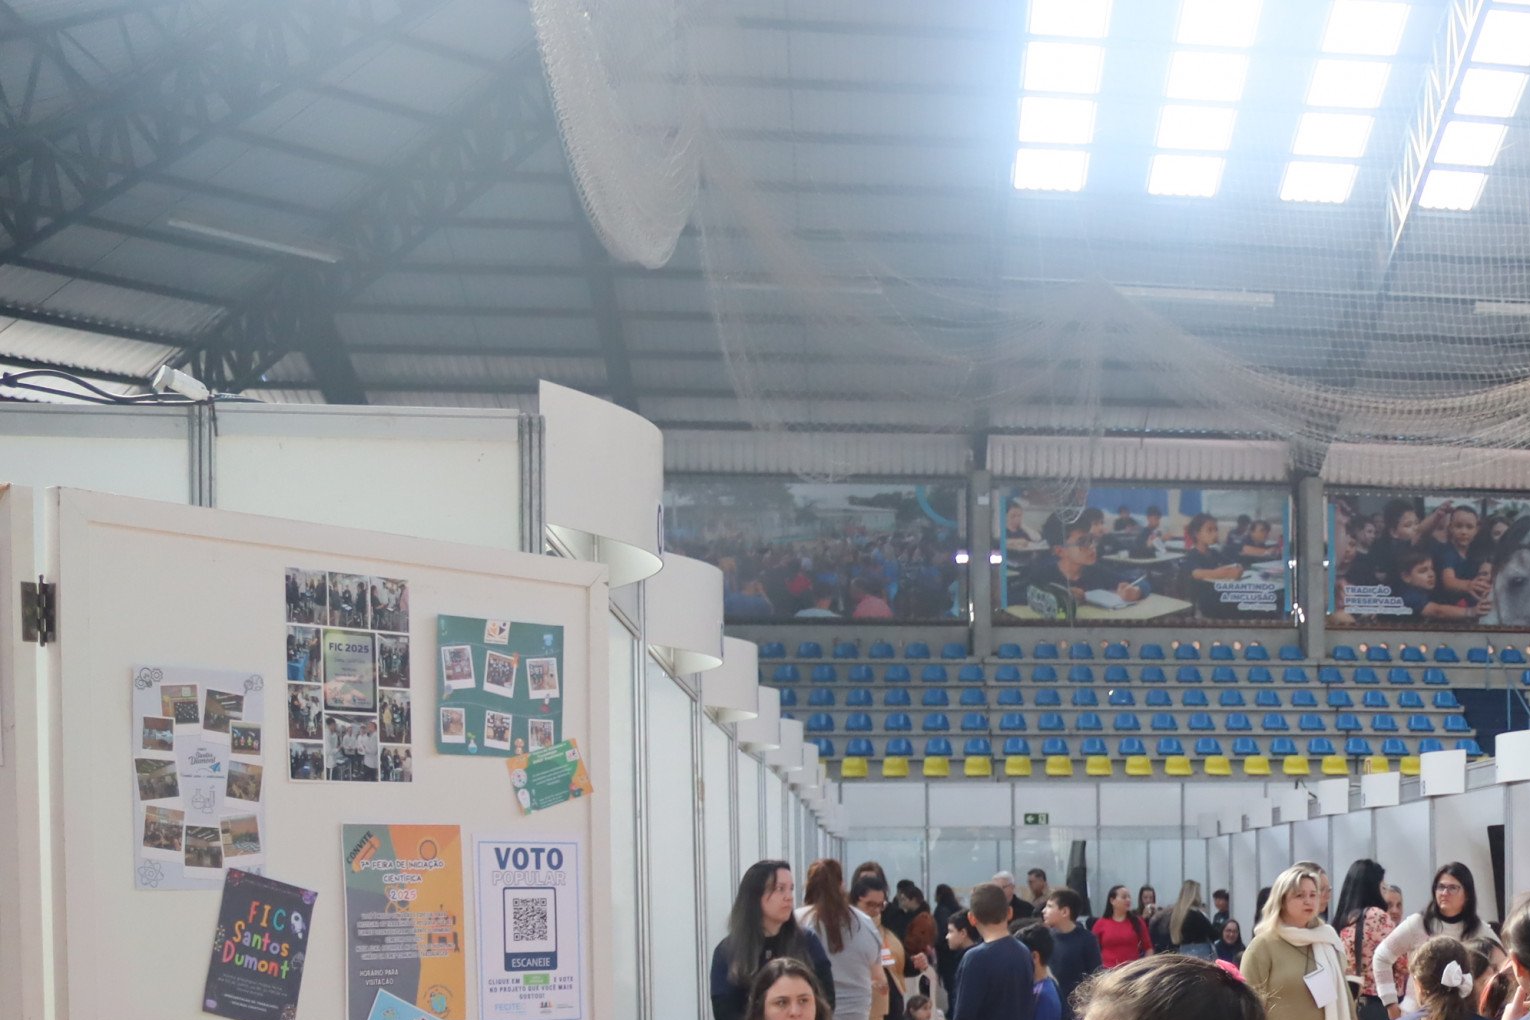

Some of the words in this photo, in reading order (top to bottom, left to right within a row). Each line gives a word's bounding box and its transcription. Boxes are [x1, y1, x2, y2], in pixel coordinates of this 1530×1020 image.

[1345, 586, 1390, 595] TRADIÇÃO
[328, 642, 343, 652] FIC
[345, 644, 370, 653] 2025
[346, 830, 374, 864] CONVITE
[406, 860, 444, 870] INICIAÇÃO
[494, 847, 564, 870] VOTO
[383, 874, 422, 882] CIENTÍFICA
[492, 870, 566, 886] POPULAR
[390, 890, 416, 900] 2025
[248, 901, 286, 931] FIC
[232, 920, 290, 957] Santos
[222, 940, 290, 979] Dumont
[512, 958, 551, 968] ESCANEIE
